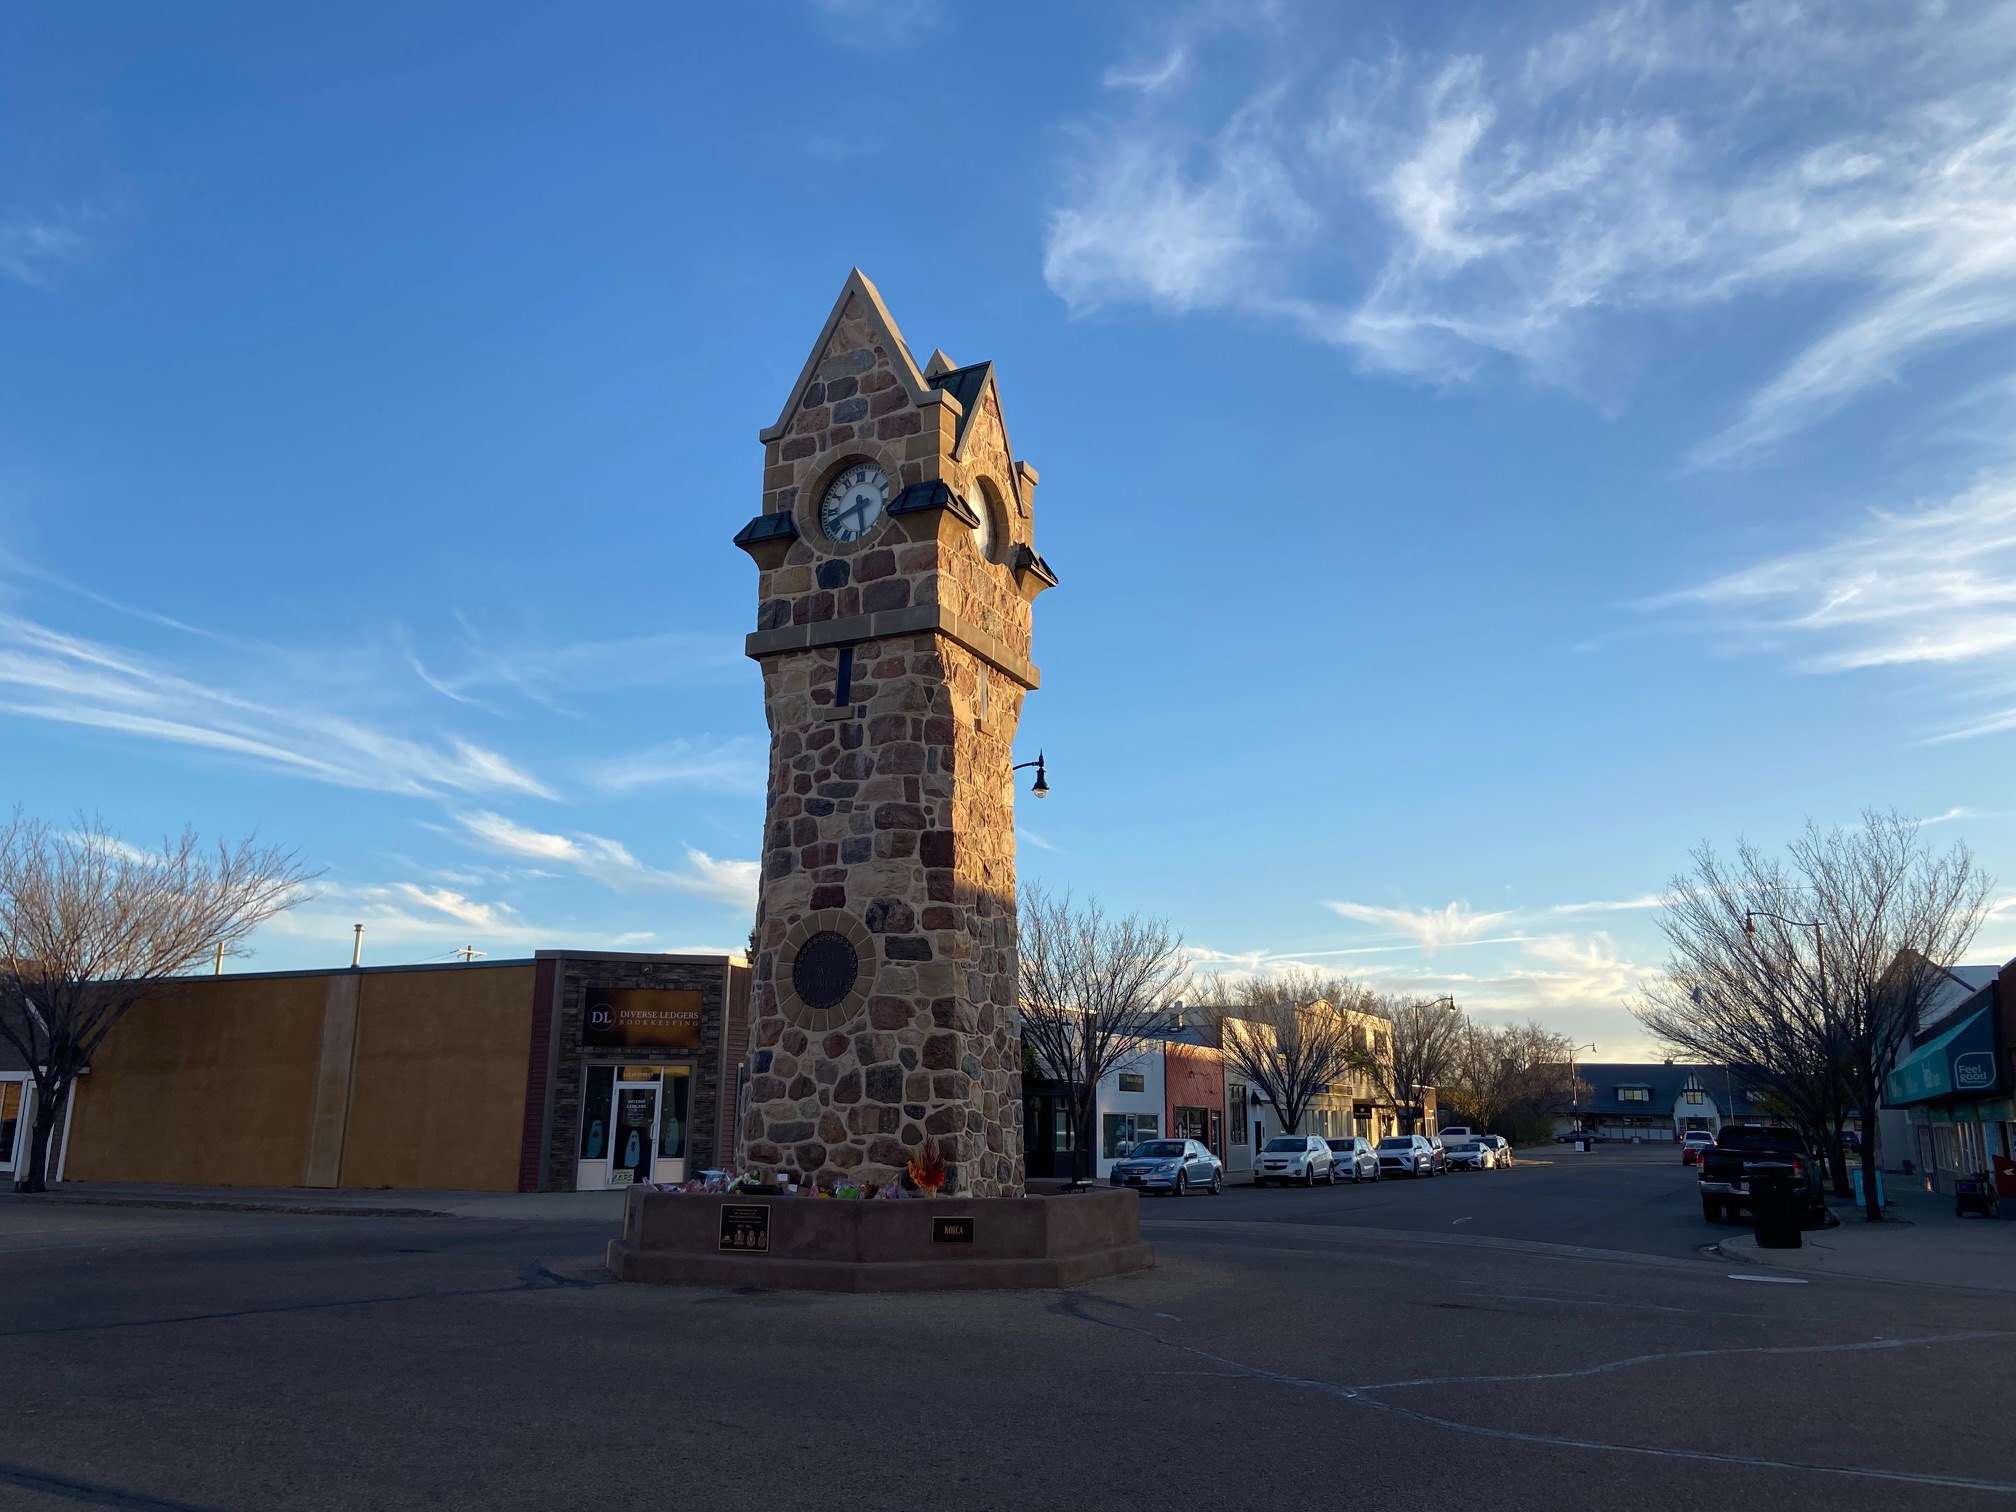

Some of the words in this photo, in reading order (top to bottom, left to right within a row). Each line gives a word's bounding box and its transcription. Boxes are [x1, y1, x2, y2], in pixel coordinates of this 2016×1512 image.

[856, 471, 866, 484] XII
[842, 479, 852, 490] XI
[832, 493, 842, 502] X
[815, 951, 836, 962] LEST
[817, 965, 833, 975] WE
[807, 977, 844, 990] FORGET
[591, 1011, 612, 1024] DL
[620, 1010, 658, 1019] DIVERSE
[660, 1011, 699, 1020] LEDGERS
[1958, 1064, 1981, 1073] Feel
[1959, 1071, 1987, 1083] good
[944, 1225, 964, 1235] KOREA
